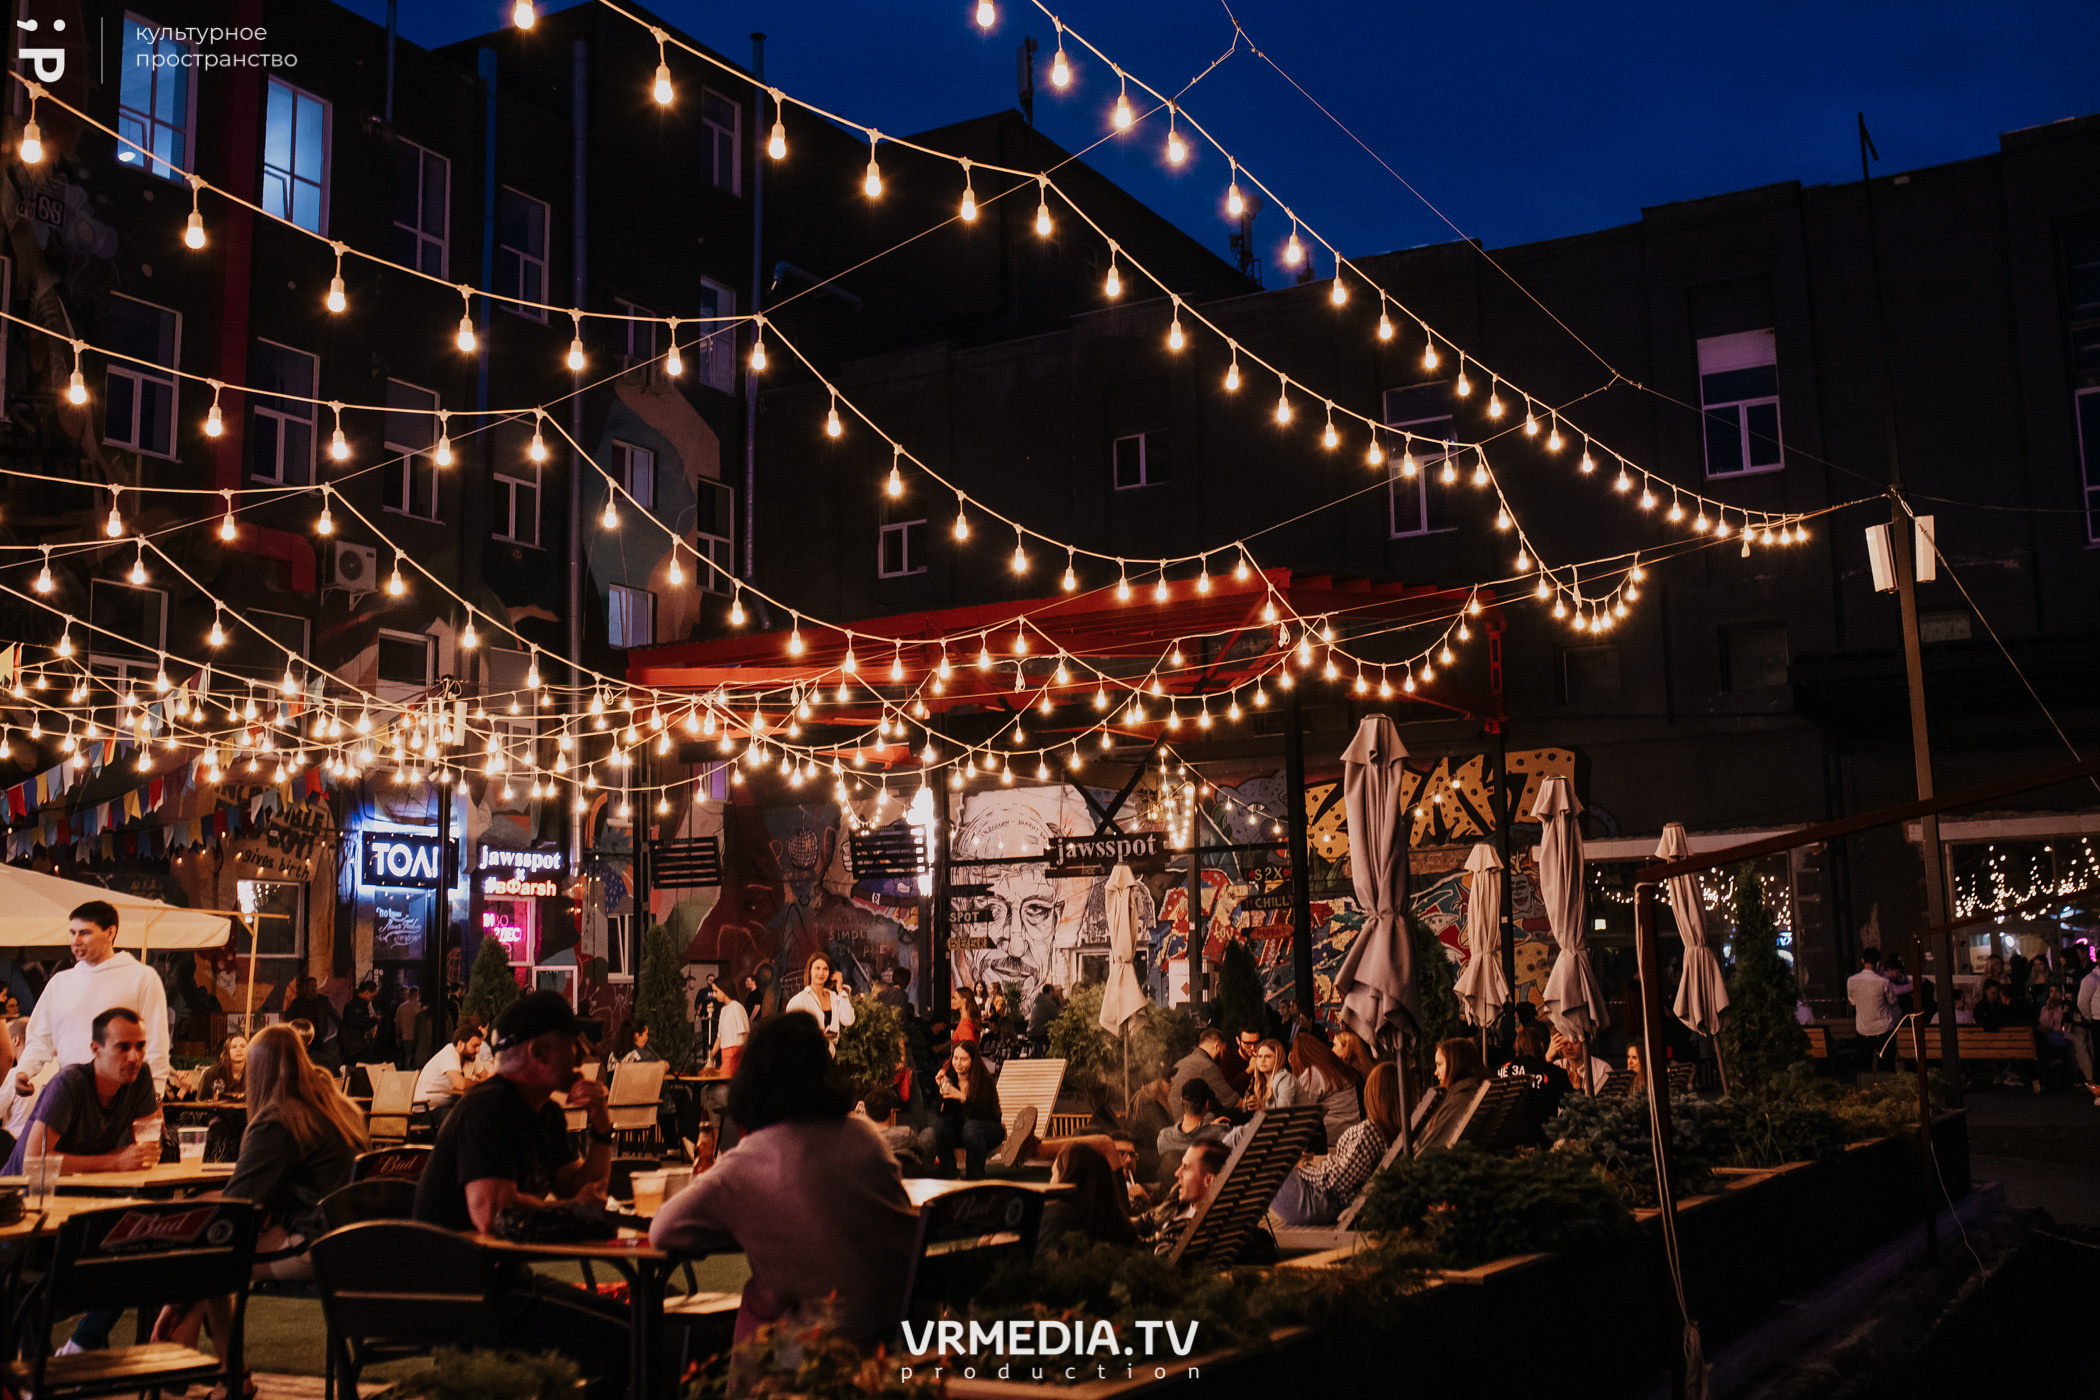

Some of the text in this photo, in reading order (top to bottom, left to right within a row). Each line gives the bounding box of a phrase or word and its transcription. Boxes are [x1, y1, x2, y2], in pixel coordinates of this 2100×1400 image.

[371, 842, 439, 879] ТОЛ
[479, 844, 561, 873] jawsspot
[1056, 833, 1157, 866] jawsspot
[241, 848, 310, 880] gives birth
[1254, 895, 1290, 909] CHILL
[948, 911, 980, 923] SPOT
[947, 936, 988, 950] BEER
[380, 1153, 420, 1174] Bud
[953, 1194, 997, 1222] Bud
[124, 1210, 193, 1239] Bud
